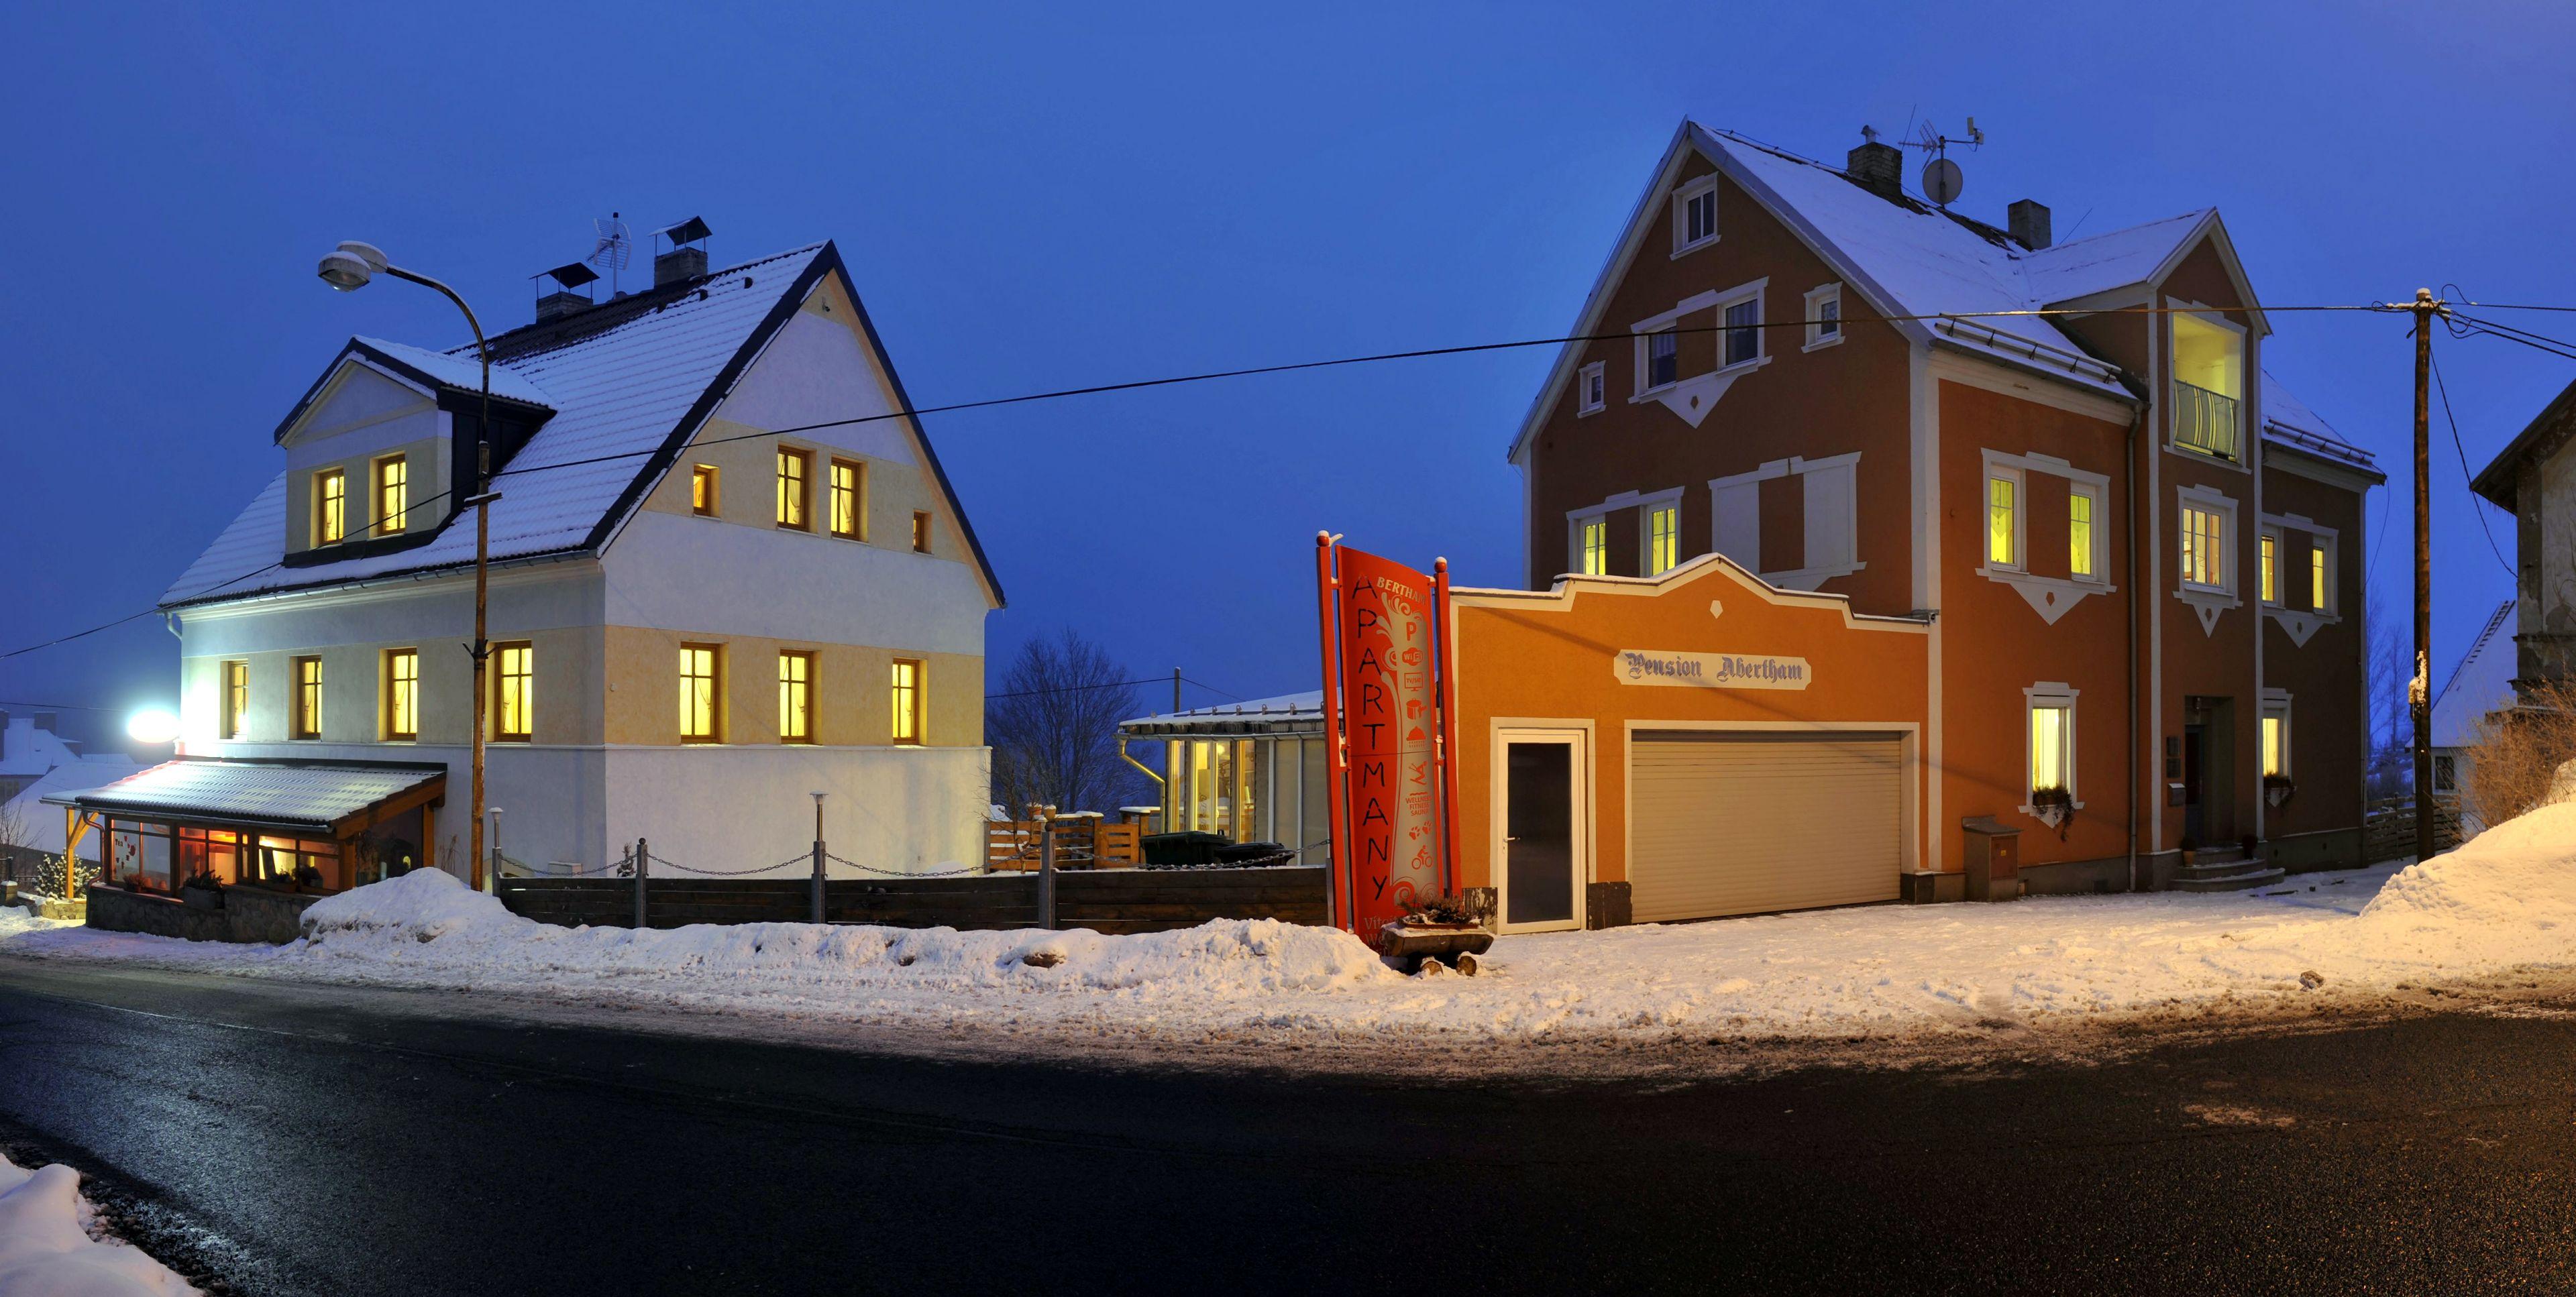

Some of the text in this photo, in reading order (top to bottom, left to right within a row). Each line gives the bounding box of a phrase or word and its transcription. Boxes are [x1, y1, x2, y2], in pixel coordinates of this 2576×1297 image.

[1406, 622, 1417, 641] P
[1624, 652, 1803, 683] Pension Abertham
